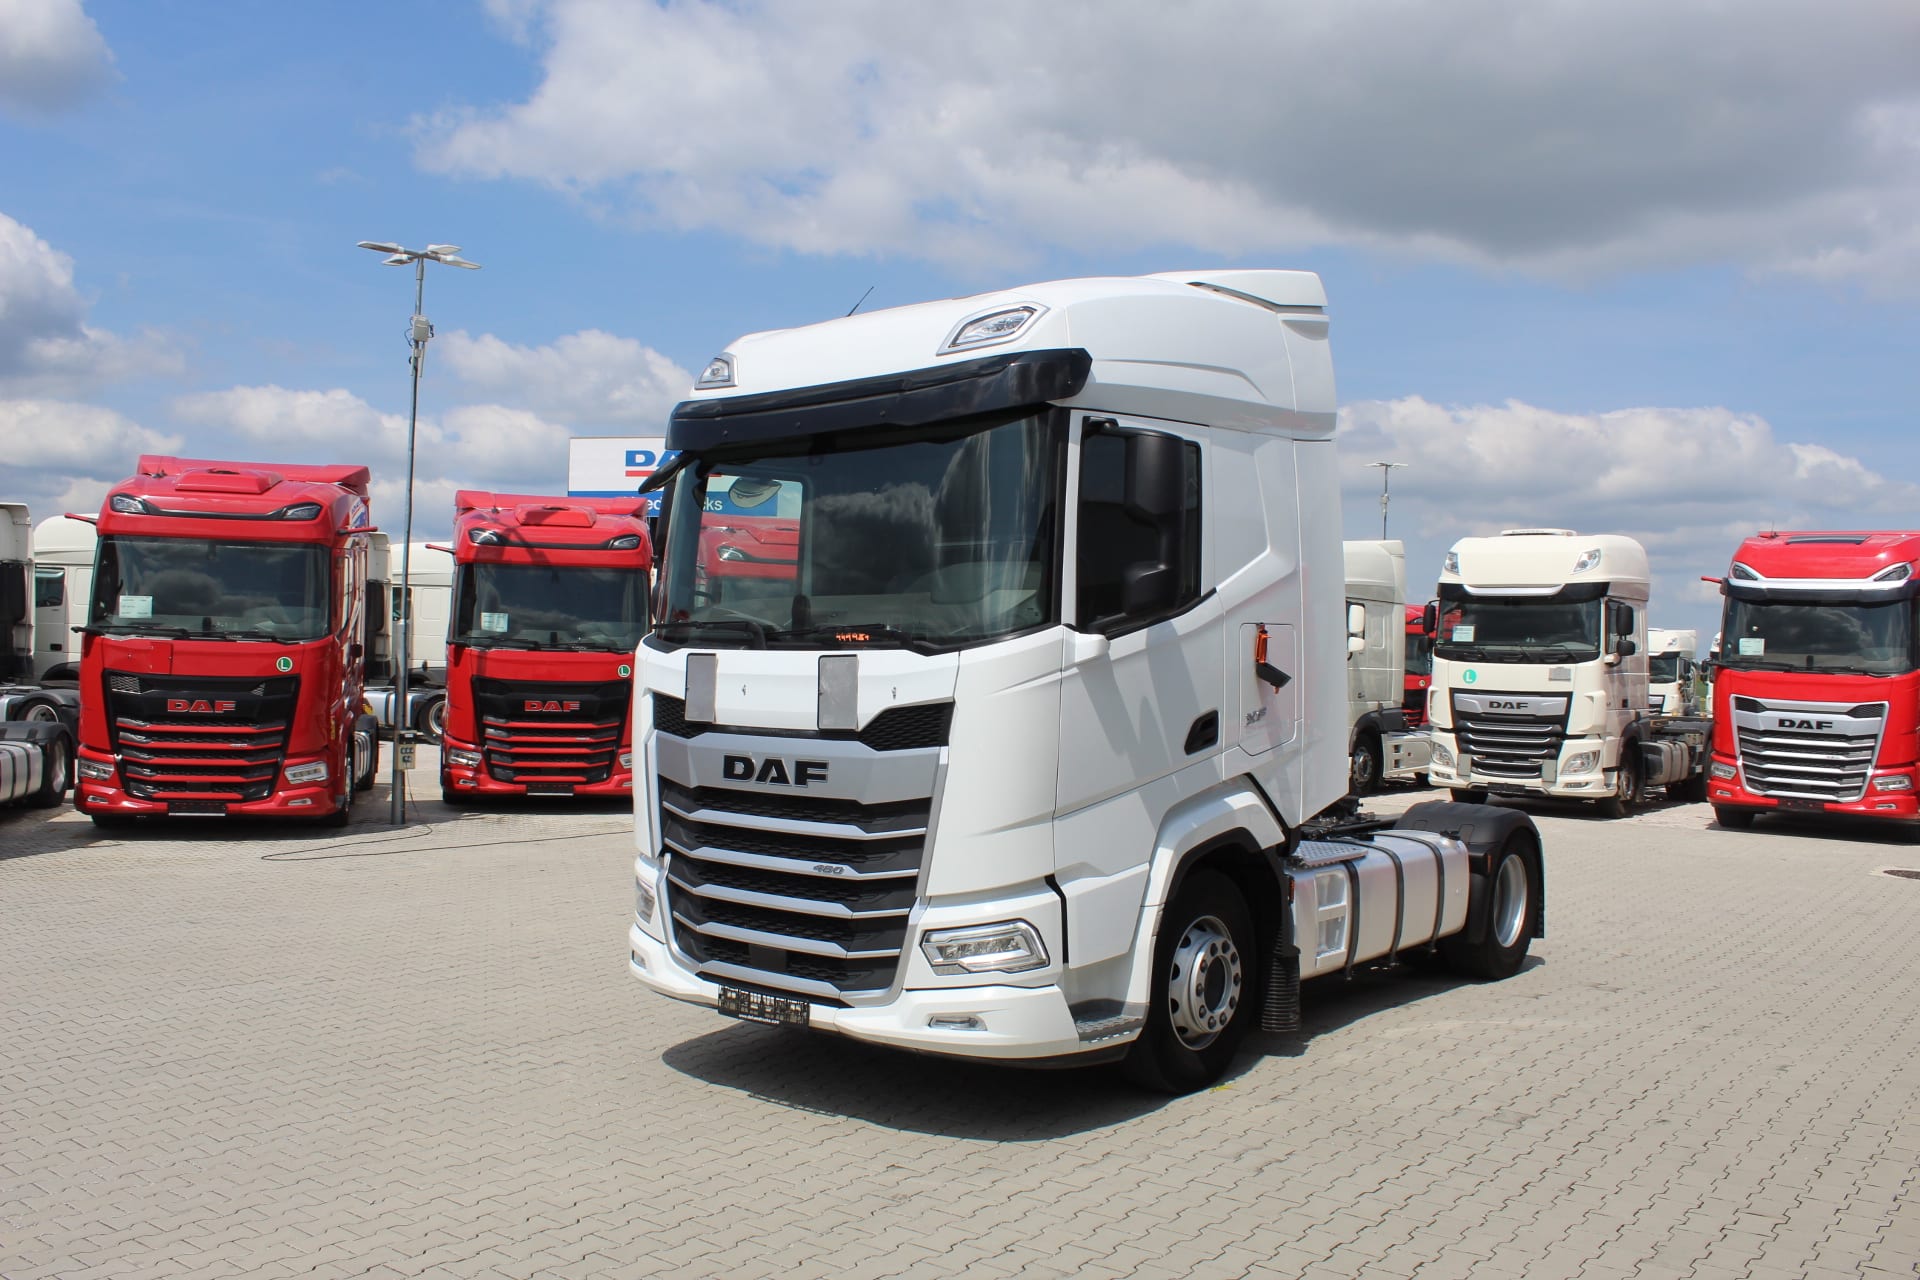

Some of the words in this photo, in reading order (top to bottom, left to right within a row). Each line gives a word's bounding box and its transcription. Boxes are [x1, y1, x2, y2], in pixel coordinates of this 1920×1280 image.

[625, 449, 684, 467] DA
[167, 698, 237, 713] DAF
[524, 700, 581, 712] DAF
[1488, 701, 1529, 710] DAF
[1778, 718, 1833, 730] DAF
[722, 753, 829, 788] DAF
